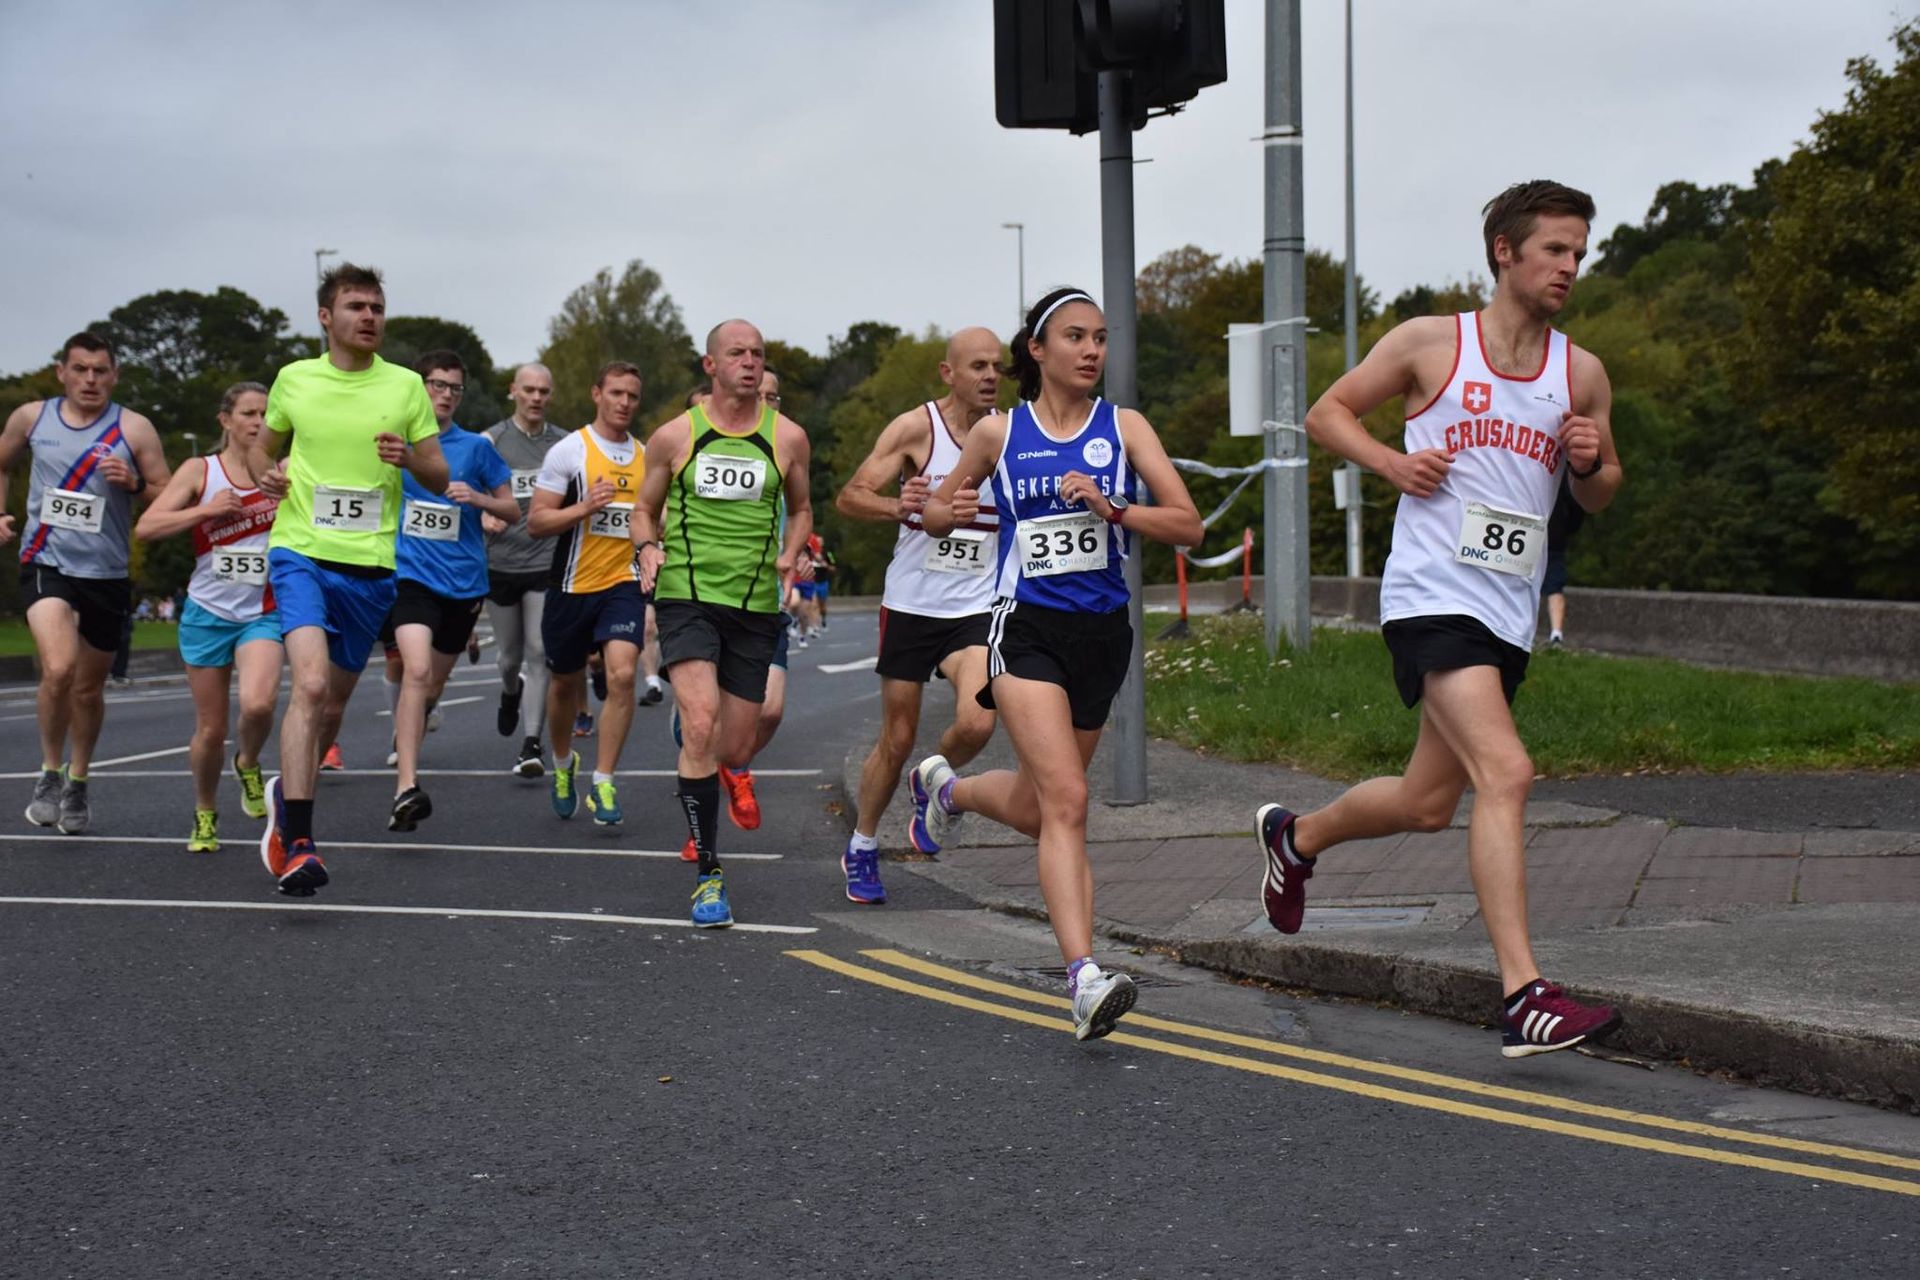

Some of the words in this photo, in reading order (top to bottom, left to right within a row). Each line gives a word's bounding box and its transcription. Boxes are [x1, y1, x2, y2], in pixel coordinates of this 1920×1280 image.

[1445, 418, 1562, 475] CRUSADERS
[703, 466, 756, 489] 300
[1017, 475, 1110, 500] SKERS
[51, 499, 92, 519] 964
[255, 511, 276, 525] CLU
[331, 498, 363, 518] 15
[411, 510, 452, 530] 289
[1030, 528, 1097, 558] 336
[1483, 523, 1526, 555] 86
[938, 541, 979, 561] 951
[1461, 546, 1489, 560] DNG
[220, 557, 265, 573] 353
[1027, 560, 1053, 571] DNG
